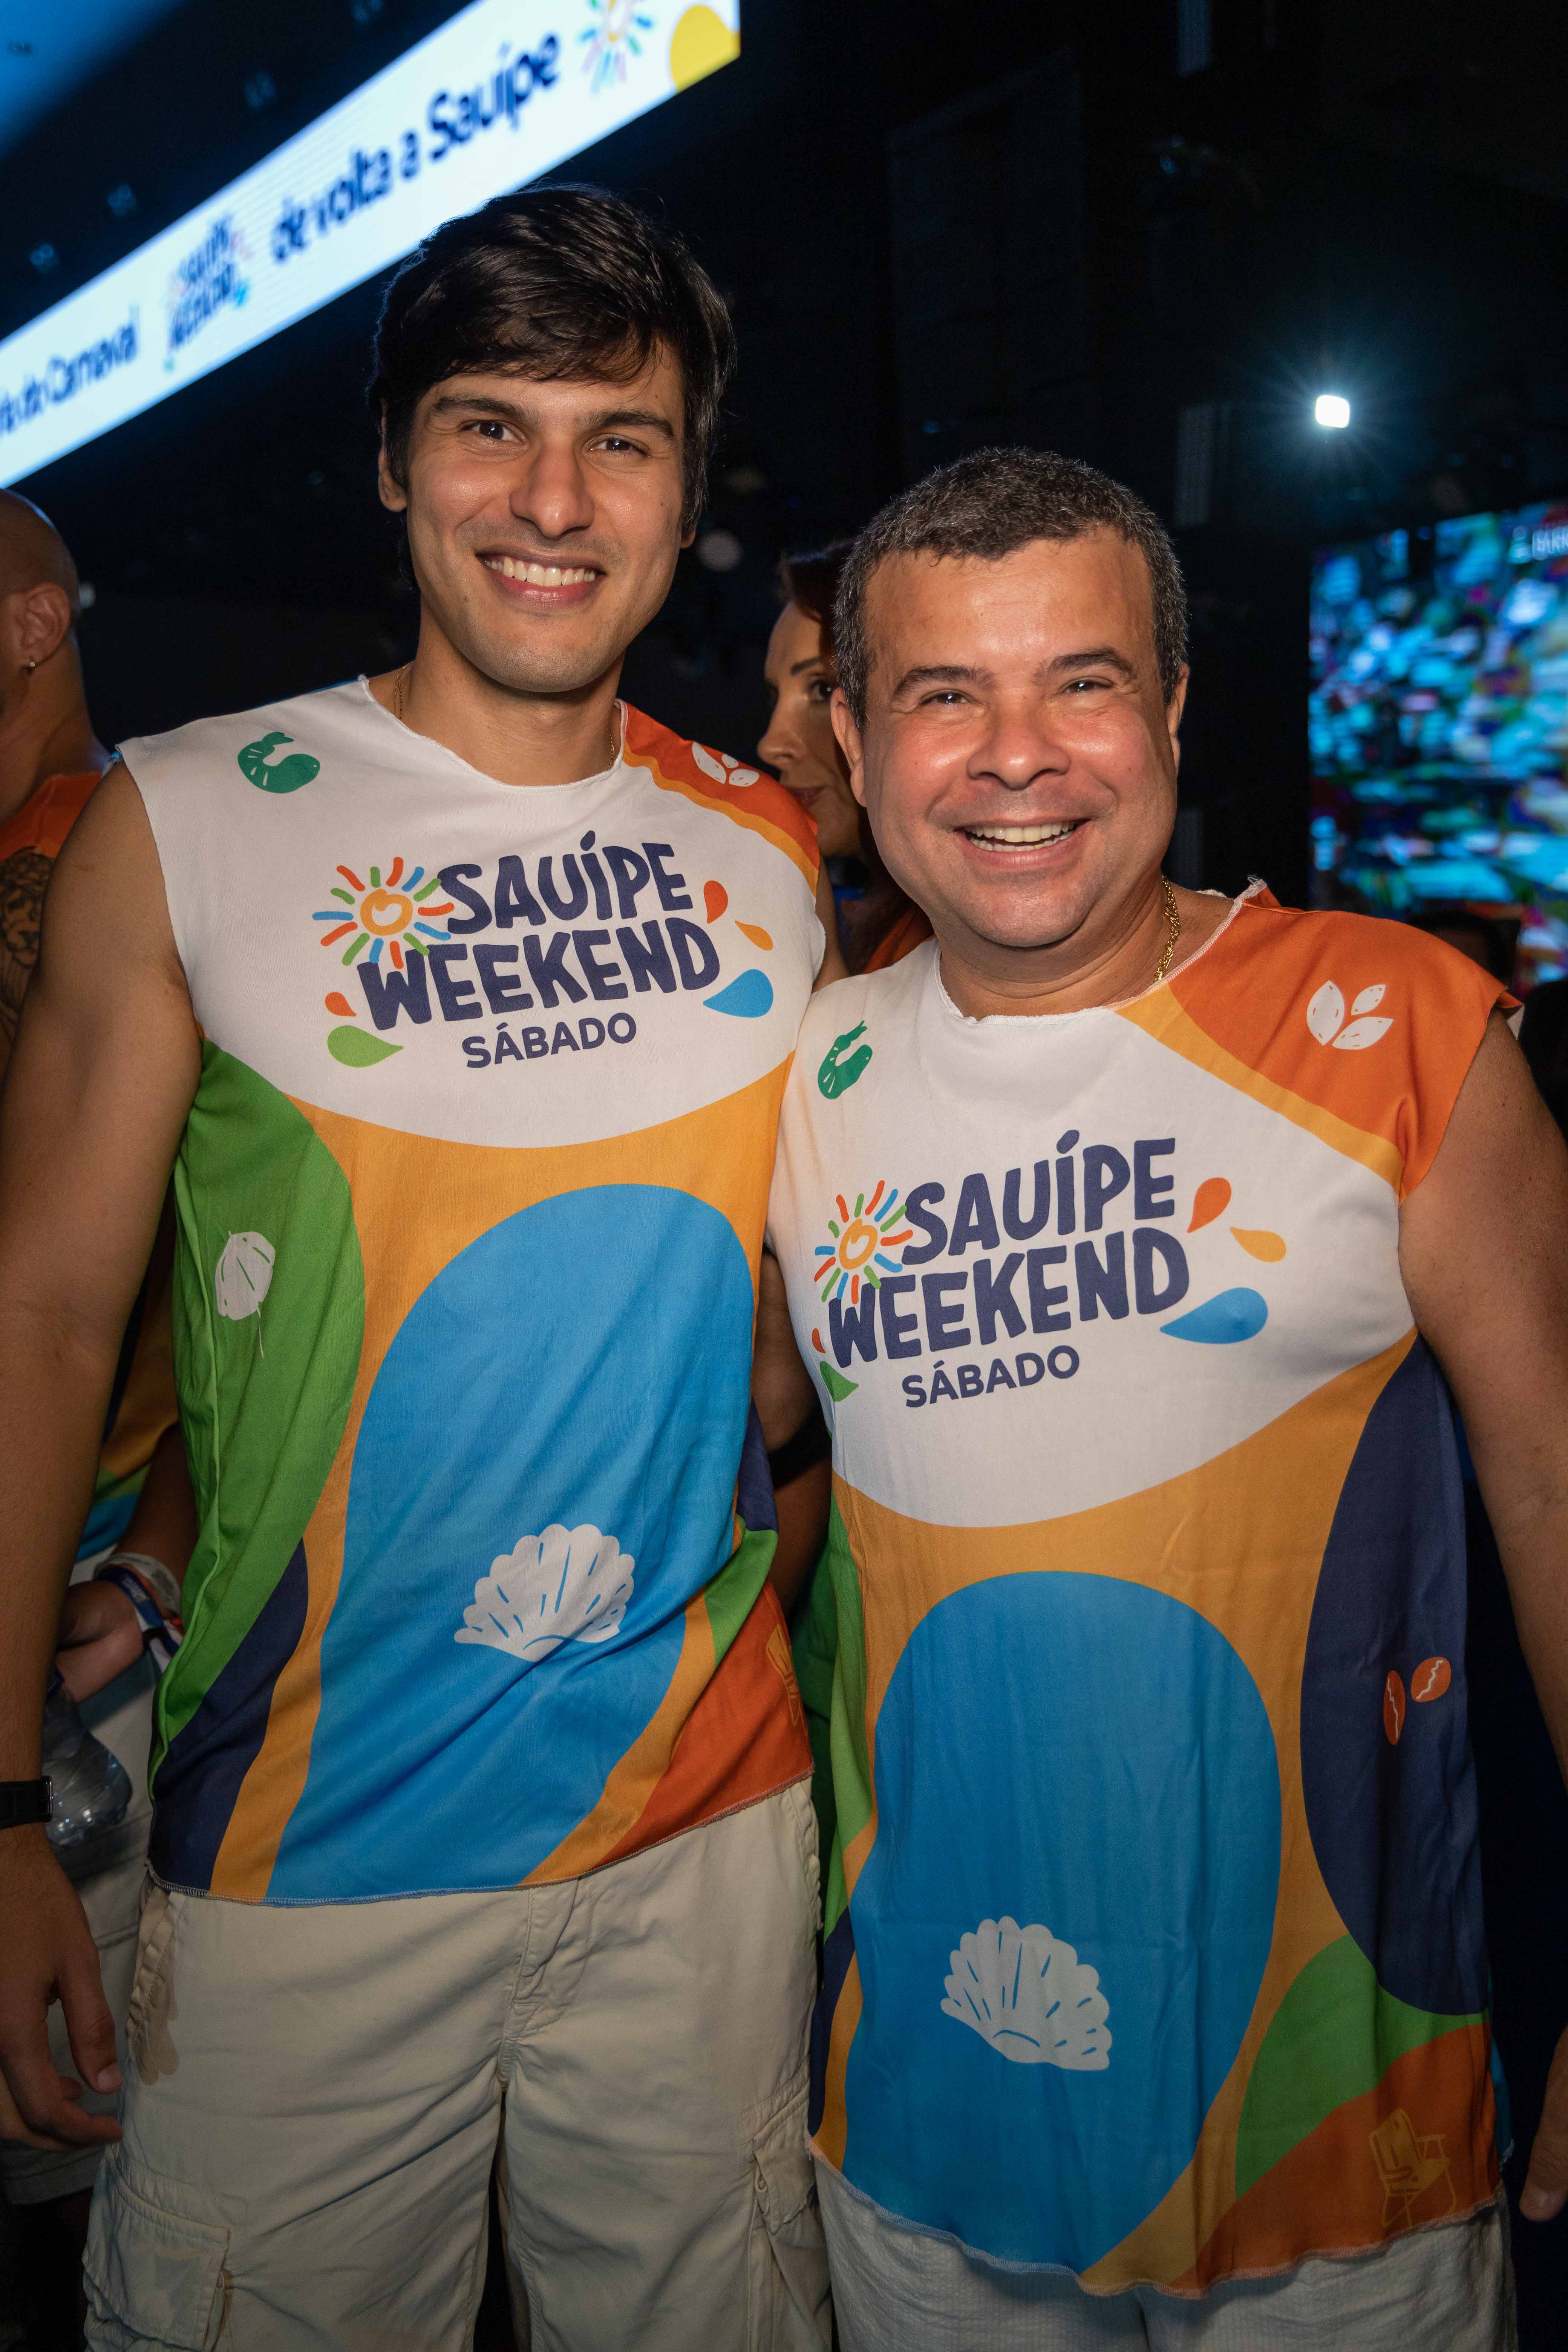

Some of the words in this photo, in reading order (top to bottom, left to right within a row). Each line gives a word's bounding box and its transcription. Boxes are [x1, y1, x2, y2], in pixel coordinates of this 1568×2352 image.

[314, 149, 391, 236] volta
[400, 129, 420, 179] a
[437, 830, 693, 934] SAUÍPE
[357, 917, 720, 1030] WEEKEND
[461, 1012, 637, 1068] SÁBADO
[901, 1129, 1176, 1265] SAUÍPE
[828, 1227, 1190, 1369] WEEKEND
[902, 1345, 1080, 1408] SÁBADO
